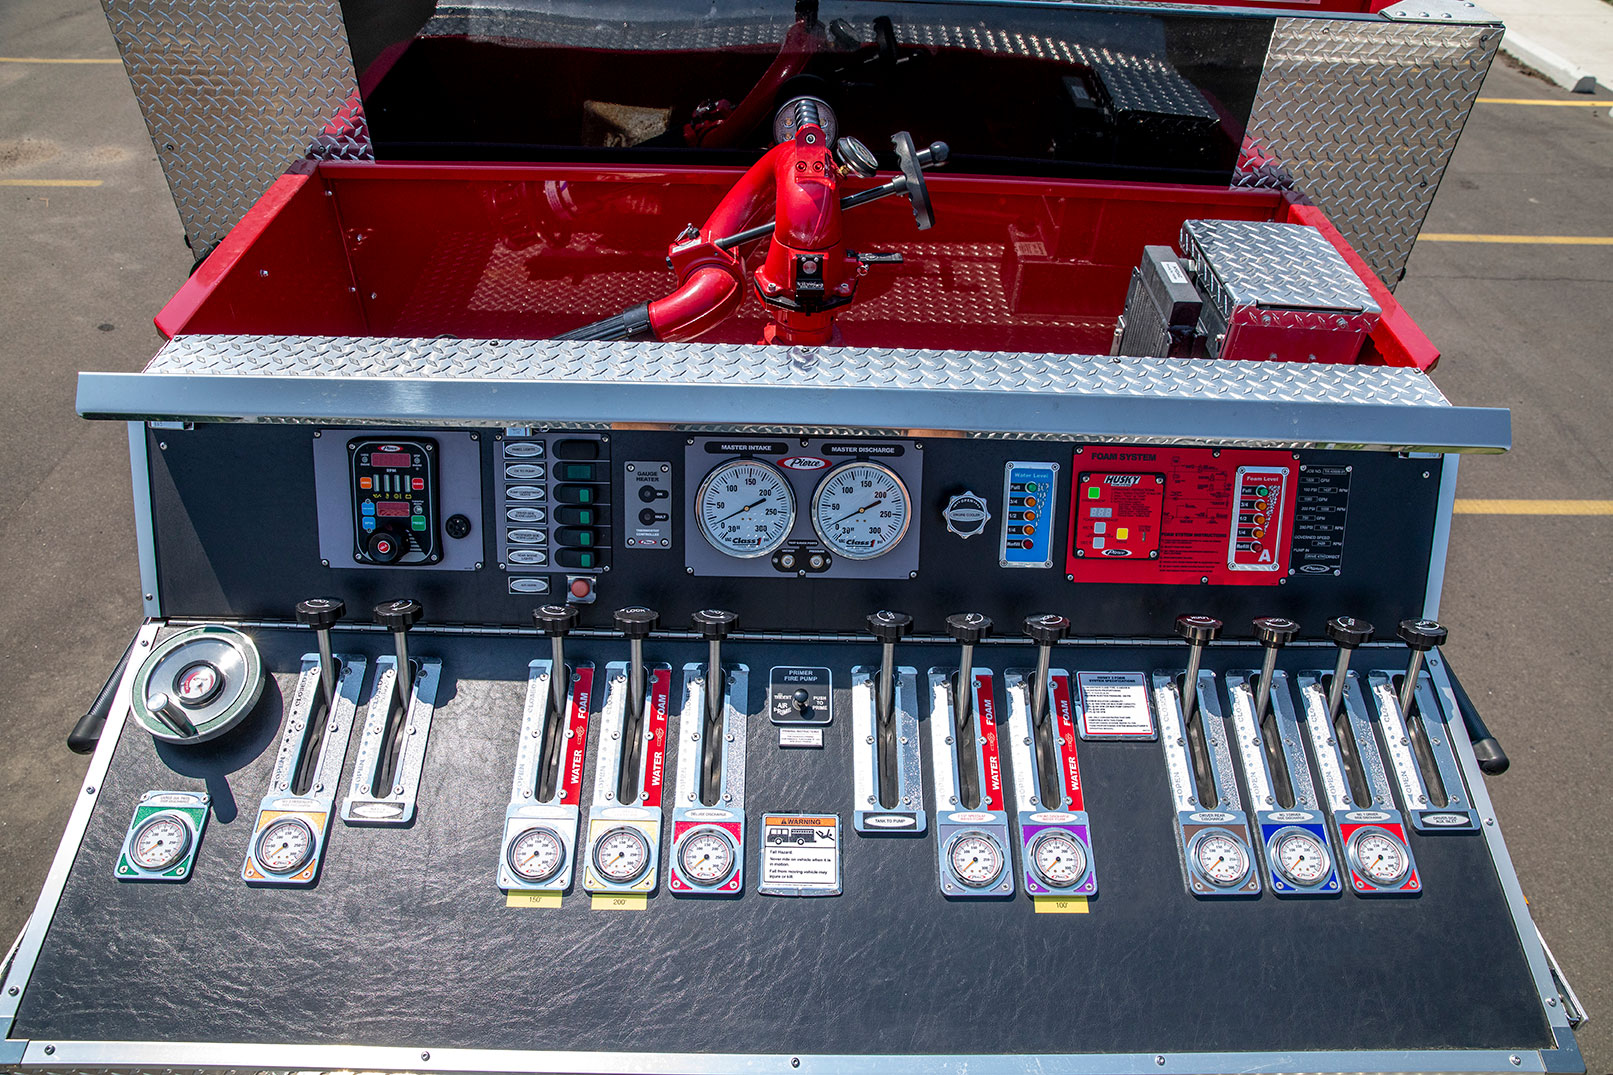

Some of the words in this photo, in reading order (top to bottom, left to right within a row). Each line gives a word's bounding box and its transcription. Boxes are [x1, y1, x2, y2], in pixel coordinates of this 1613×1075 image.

[790, 458, 821, 469] Pierce
[1119, 453, 1156, 461] SYSTEM
[1104, 475, 1141, 484] HUSKY
[874, 491, 887, 499] 200
[732, 537, 762, 545] Class1
[846, 539, 876, 547] Class1
[1258, 549, 1271, 562] A
[295, 677, 308, 707] CLOSED
[983, 699, 994, 726] FOAM
[1061, 700, 1071, 727] FOAM
[570, 749, 582, 784] WATER
[577, 692, 589, 719] FOAM
[651, 751, 662, 786] WATER
[657, 694, 667, 721] FOAM
[991, 756, 1000, 791] WATER
[1069, 757, 1080, 791] WATER
